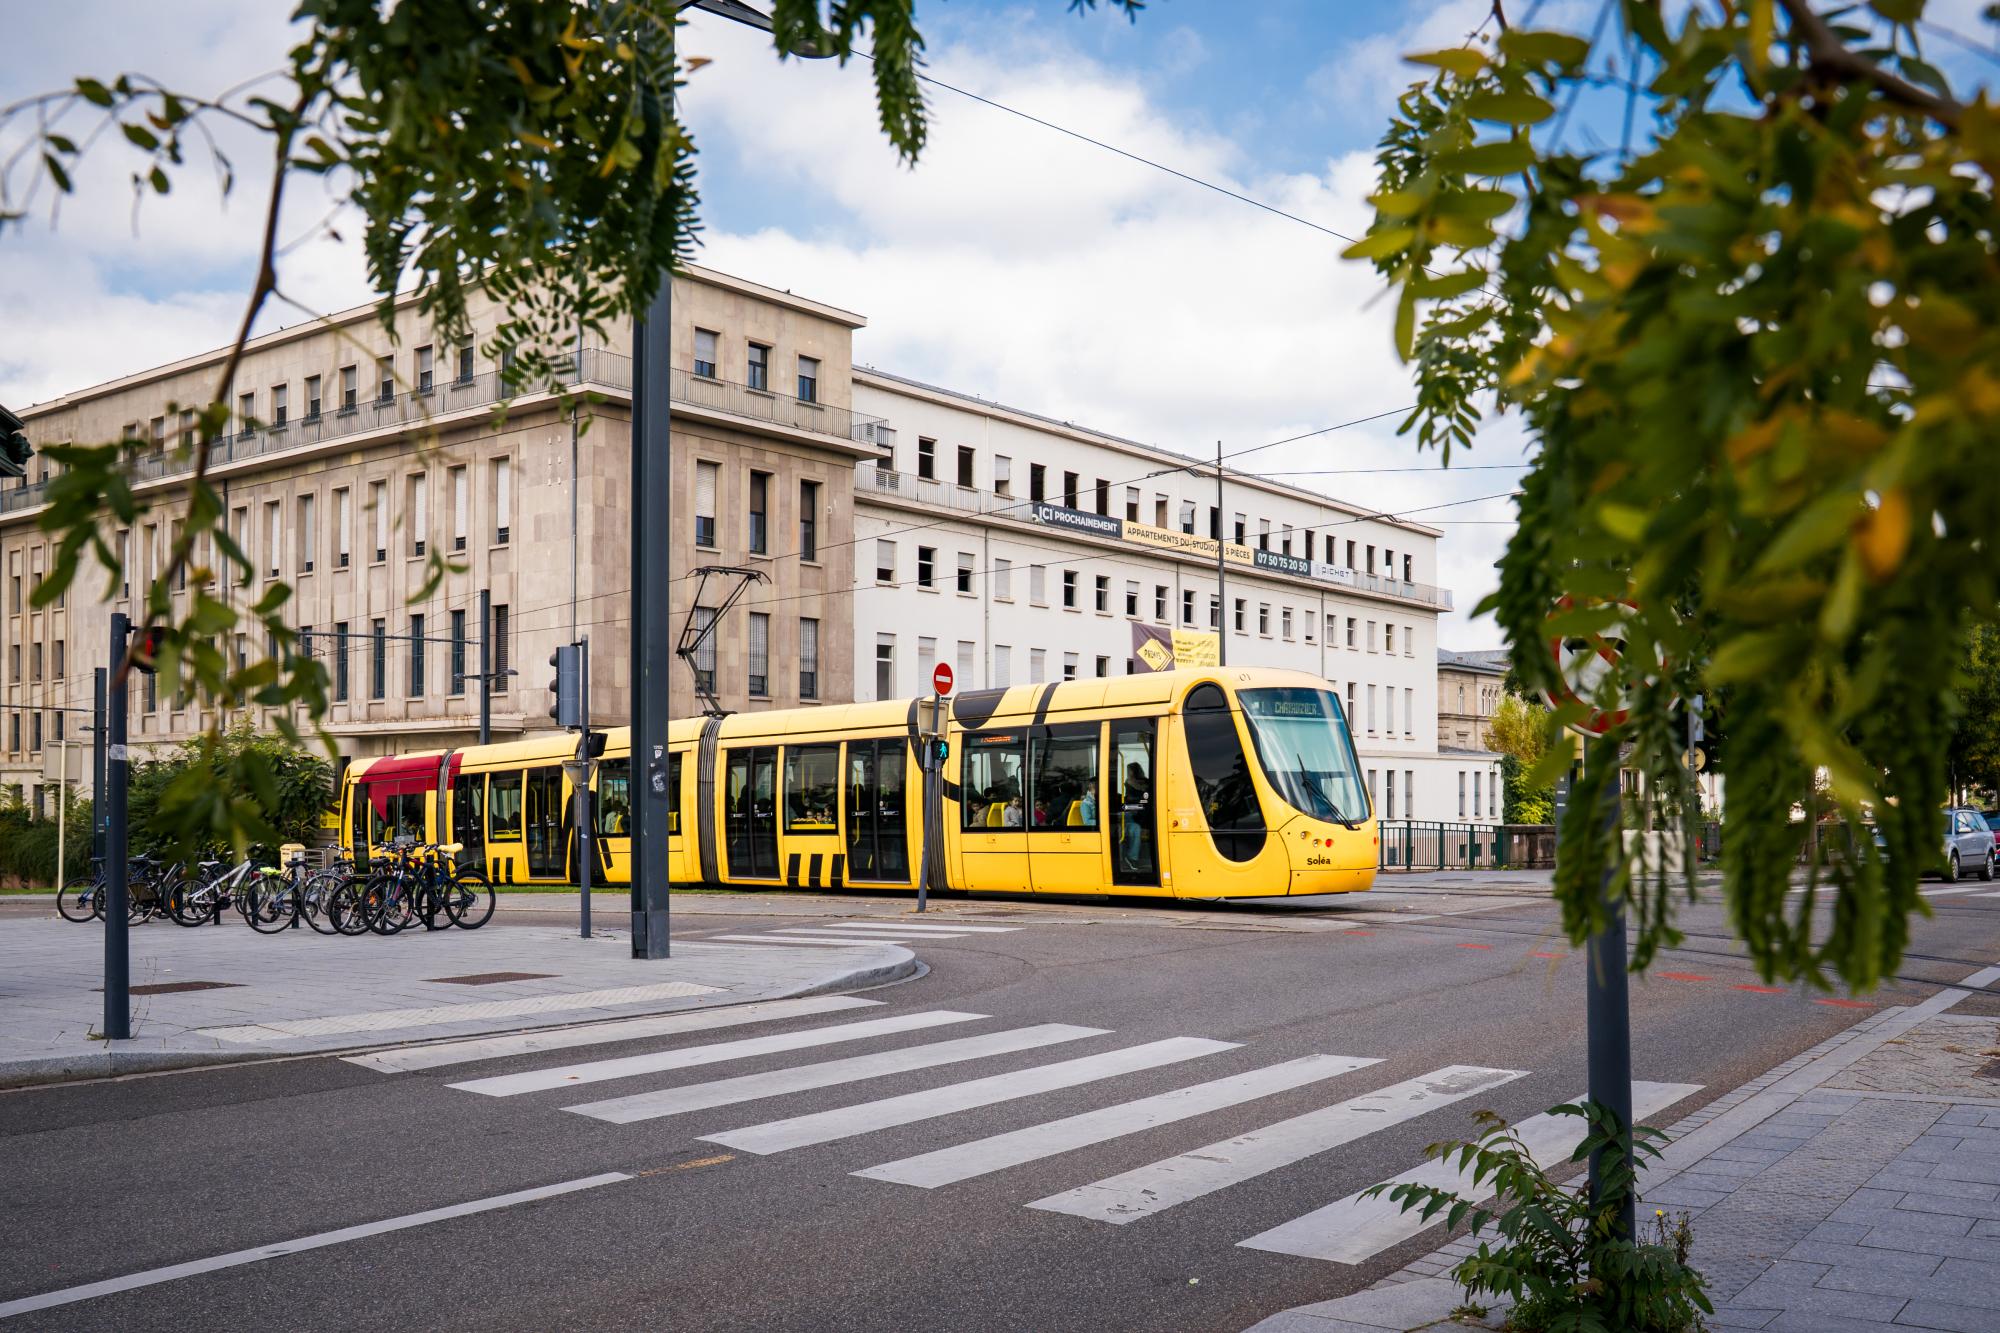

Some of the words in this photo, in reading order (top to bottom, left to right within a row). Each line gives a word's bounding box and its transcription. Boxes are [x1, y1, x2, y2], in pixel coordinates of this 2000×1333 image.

[1038, 506, 1053, 521] ICI
[1054, 511, 1118, 532] PROCHAINEMENT
[1127, 526, 1179, 545] APPARTEMENTS
[1192, 540, 1215, 552] STUDIO
[1230, 548, 1250, 560] PIÈCES
[1257, 552, 1267, 564] 07
[1268, 554, 1278, 566] 50
[1278, 556, 1288, 569] 75
[1288, 558, 1298, 571] 20
[1298, 561, 1308, 573] 50
[1306, 853, 1331, 866] Soléa
